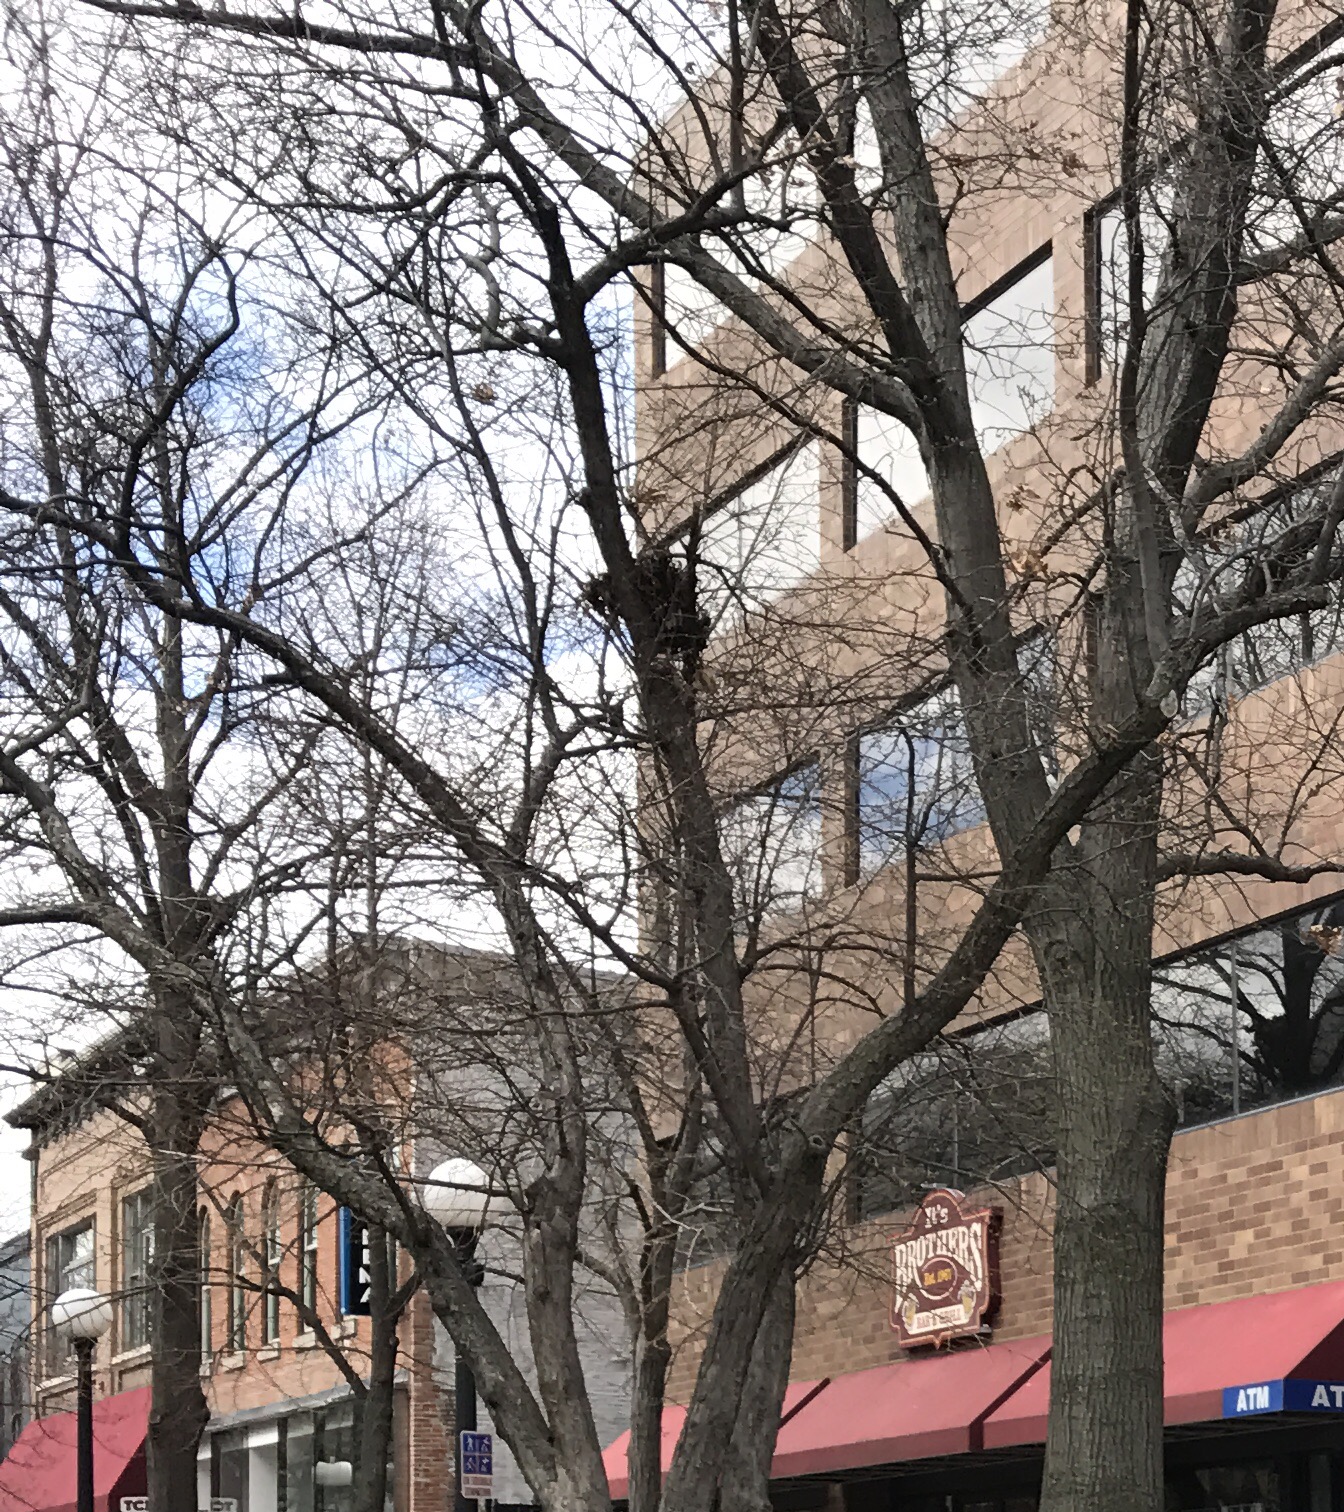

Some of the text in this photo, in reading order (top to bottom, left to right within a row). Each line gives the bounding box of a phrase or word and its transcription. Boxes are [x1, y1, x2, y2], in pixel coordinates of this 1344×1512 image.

[924, 1204, 949, 1228] It's
[894, 1222, 982, 1314] BROTHERS
[1236, 1385, 1269, 1412] ATM
